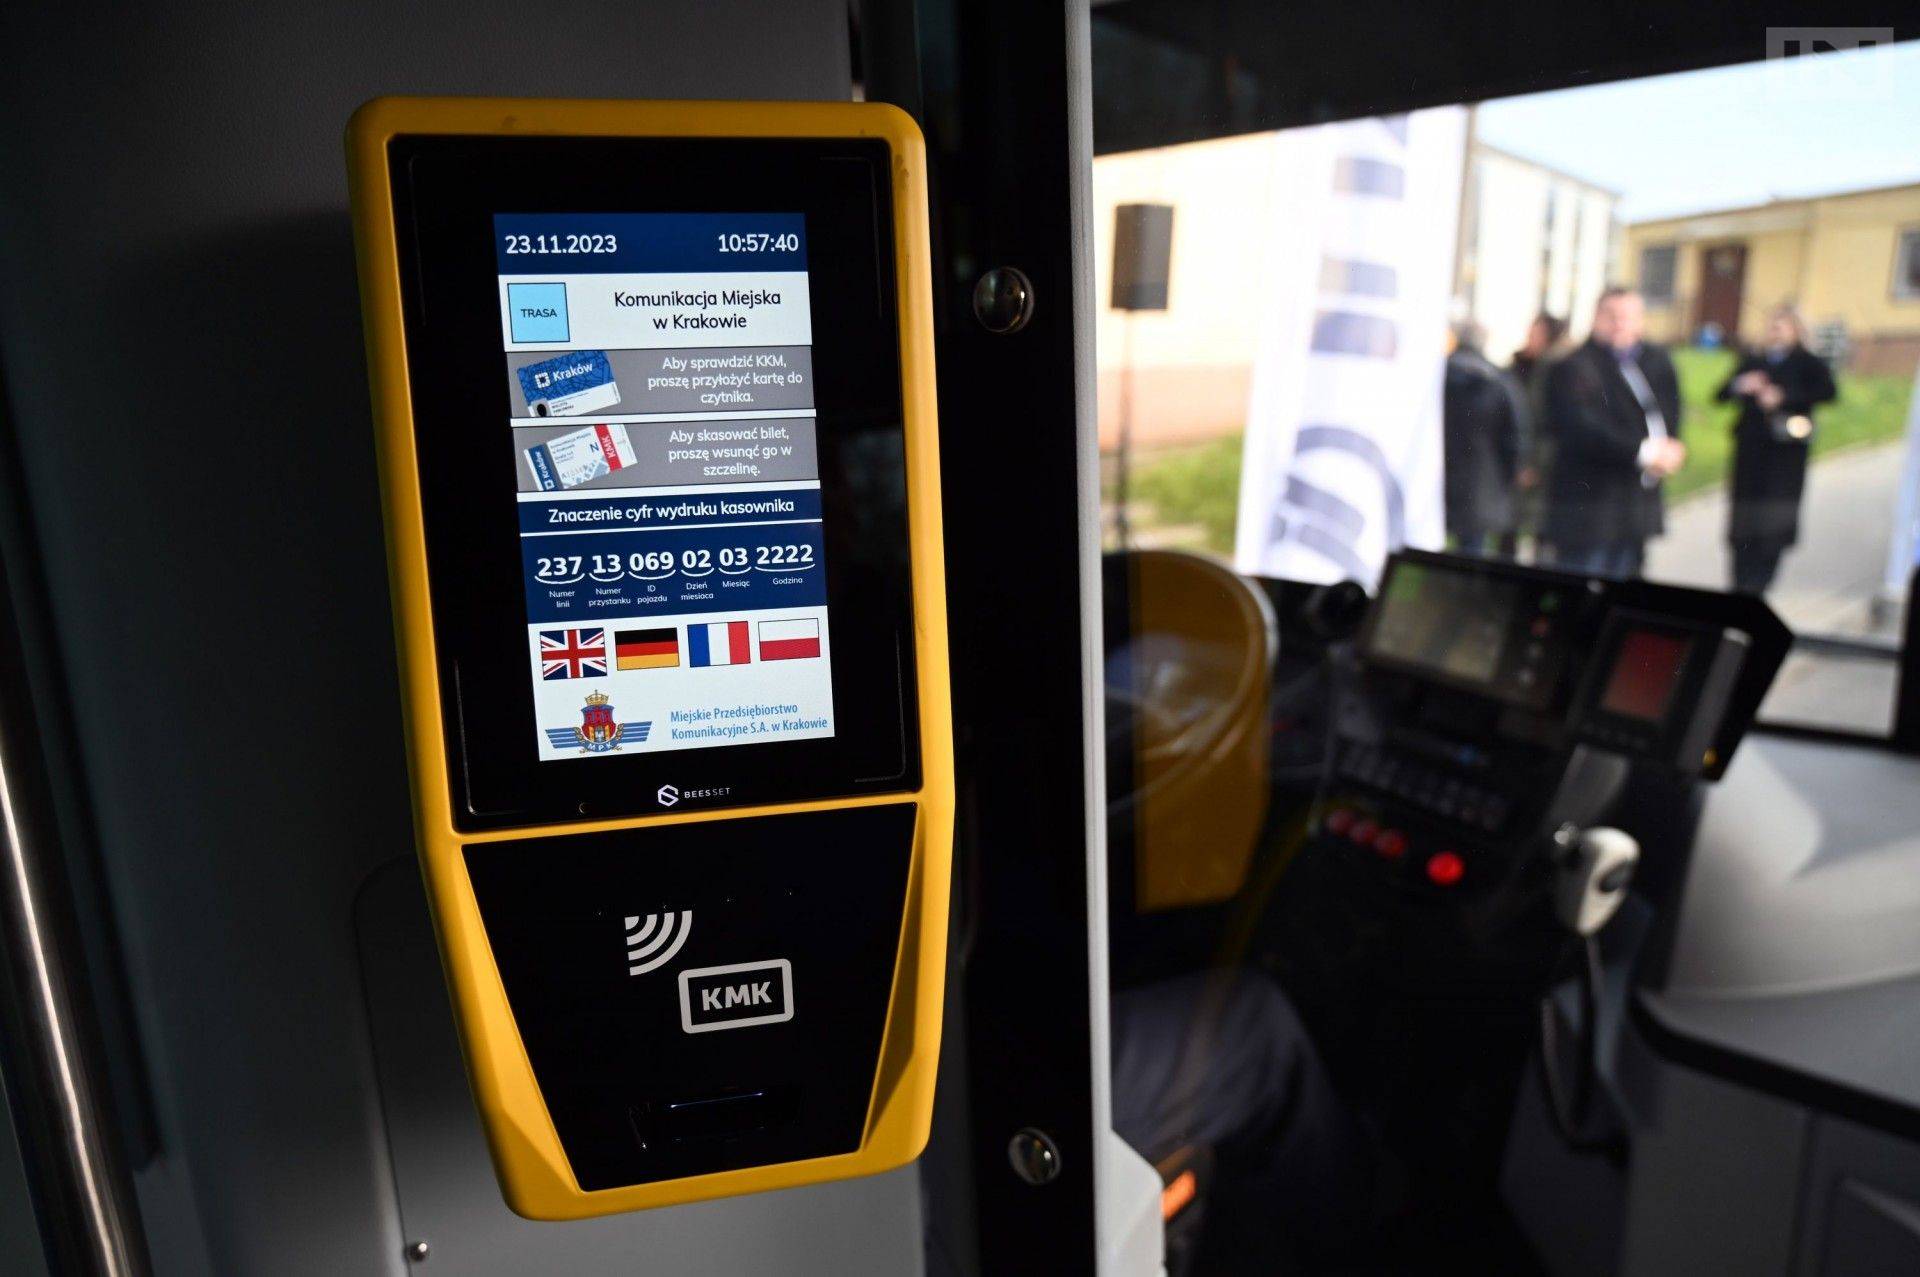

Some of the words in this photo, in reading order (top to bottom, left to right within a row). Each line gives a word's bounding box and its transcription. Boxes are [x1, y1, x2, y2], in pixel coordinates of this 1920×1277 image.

[504, 233, 618, 255] 23.11.2023
[717, 232, 800, 253] 10:57:40
[613, 290, 718, 311] Komunikacja
[721, 289, 782, 309] Miejska
[520, 307, 558, 319] TRASA
[652, 317, 668, 331] w
[672, 314, 748, 331] Krakowie
[552, 361, 594, 382] Kraków
[661, 355, 689, 372] Aby
[690, 354, 754, 371] sprawdzić
[755, 353, 787, 369] KKM,
[647, 376, 690, 391] proszę
[692, 373, 751, 390] przyłożyć
[752, 372, 785, 387] kartę
[787, 371, 804, 386] do
[700, 392, 756, 407] czytnika.
[668, 430, 694, 445] Aby
[696, 428, 759, 442] skasować
[760, 426, 790, 441] bilet,
[602, 435, 616, 459] KMK
[667, 448, 711, 463] proszę
[712, 446, 760, 461] wsunąć
[762, 447, 778, 460] go
[782, 445, 793, 456] w
[535, 451, 549, 479] Kraków
[702, 461, 762, 478] szczelinę.
[548, 507, 623, 524] Znaczenie
[625, 503, 655, 522] cyfr
[656, 502, 718, 519] wydruku
[720, 498, 796, 516] kasownika
[537, 555, 583, 577] 237
[592, 554, 621, 574] 13
[629, 551, 675, 572] 069
[682, 549, 712, 569] 02
[719, 547, 749, 567] 03
[757, 543, 814, 566] 2222
[685, 581, 708, 590] Dzień
[722, 580, 751, 589] Miesiąc
[772, 576, 804, 585] Godzina
[548, 590, 576, 598] Numer
[595, 587, 622, 595] Numer
[637, 594, 668, 605] pojazdu
[556, 600, 570, 608] linii
[588, 597, 632, 608] przystanku
[670, 709, 712, 725] Miejskie
[713, 703, 798, 720] Przedsiębiorstwo
[671, 723, 748, 740] Komunikacyjne
[750, 721, 769, 735] S.A.
[771, 721, 781, 732] w
[782, 716, 828, 731] Krakowie
[587, 741, 613, 751] MPK
[683, 786, 732, 799] BEESSET
[700, 980, 774, 1012] KMK
